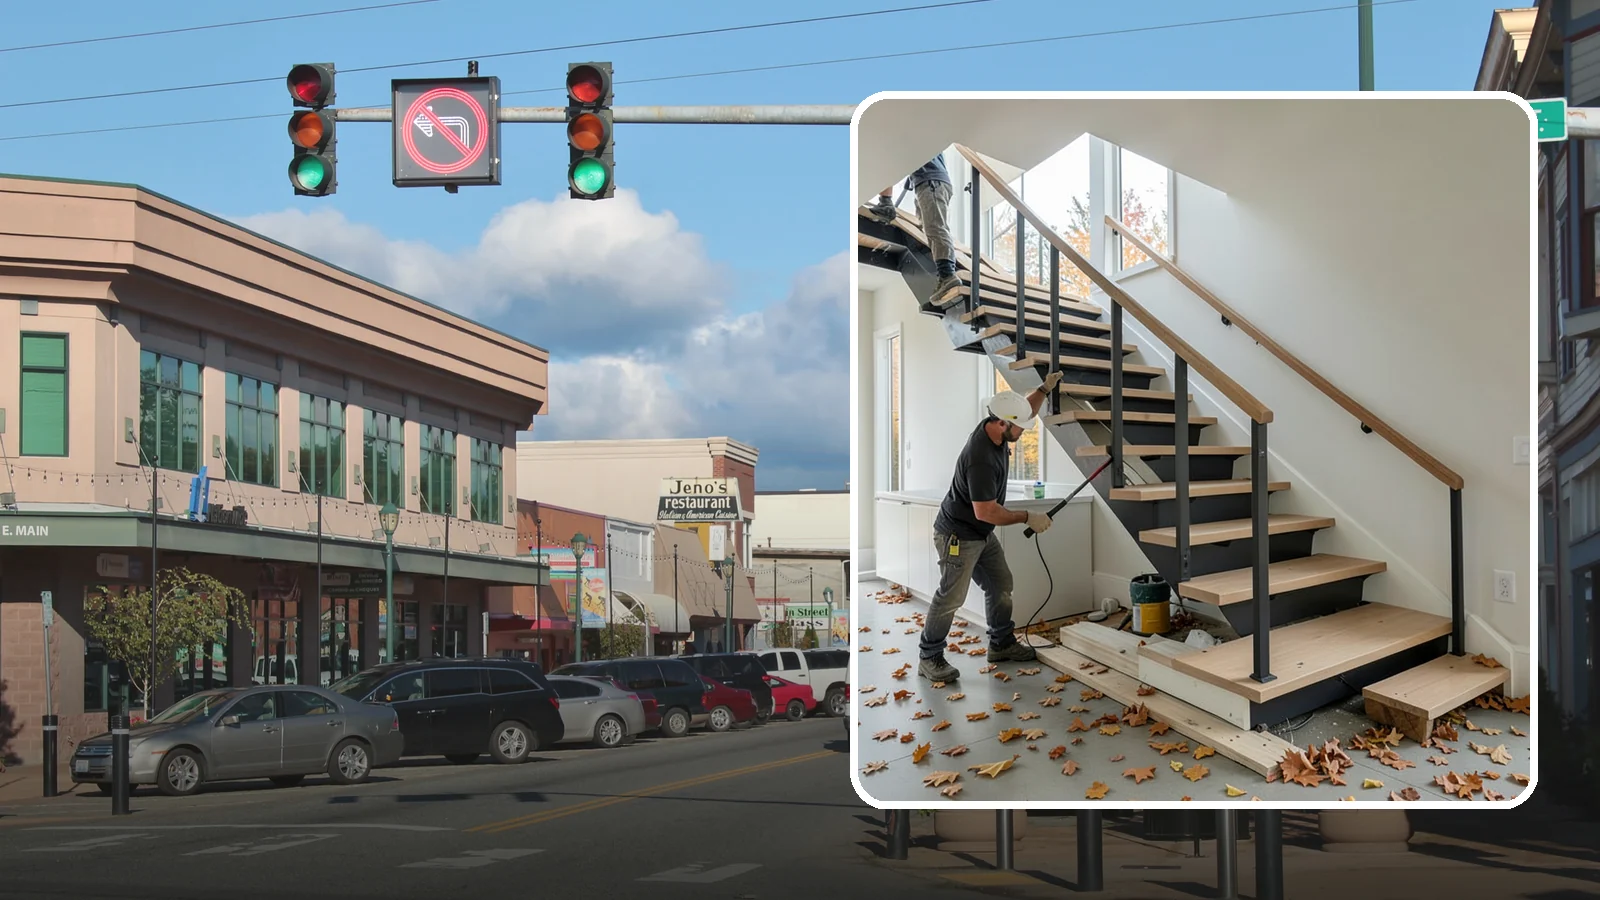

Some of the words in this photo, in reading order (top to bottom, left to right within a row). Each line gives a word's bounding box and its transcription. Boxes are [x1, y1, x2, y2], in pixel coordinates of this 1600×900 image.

[669, 480, 728, 495] Jeno's
[665, 496, 731, 509] restaurant
[659, 510, 681, 519] Italian
[686, 510, 714, 519] American
[715, 510, 737, 519] Cuisine
[2, 525, 13, 536] E.
[15, 525, 49, 536] MAIN
[797, 607, 828, 617] Street
